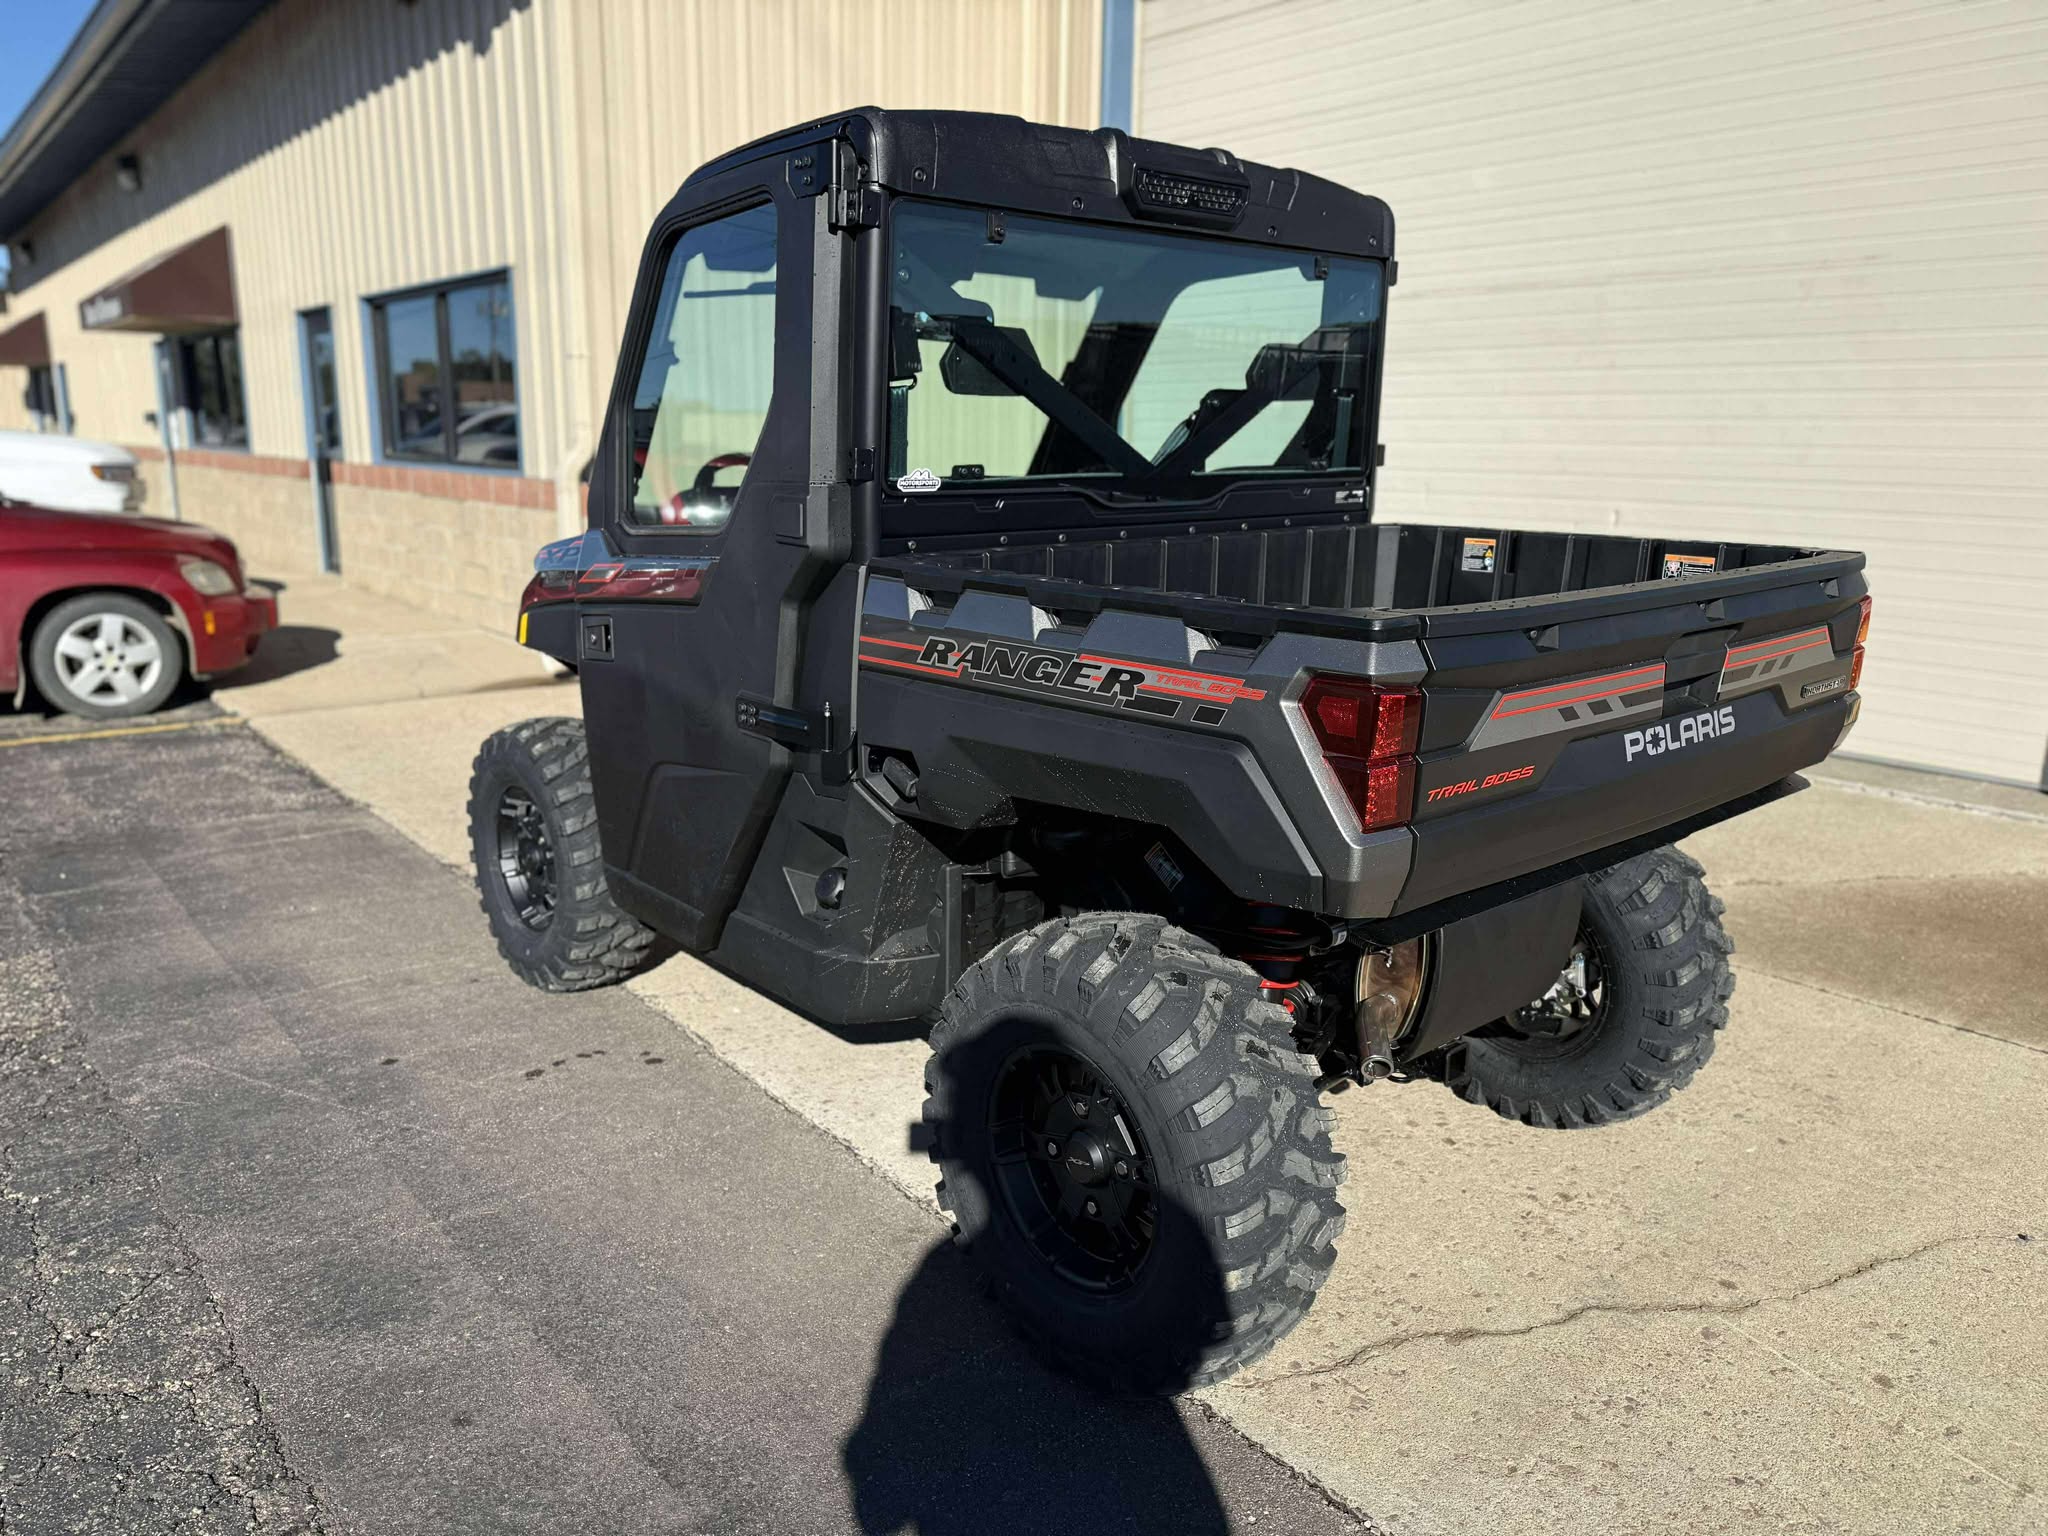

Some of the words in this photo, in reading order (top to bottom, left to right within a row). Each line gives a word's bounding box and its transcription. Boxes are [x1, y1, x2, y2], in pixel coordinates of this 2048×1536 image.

[917, 636, 1146, 700] RANGER
[1156, 674, 1205, 690] TRAIL
[1207, 683, 1267, 701] BOSS
[1623, 706, 1736, 762] POLARIS
[1427, 779, 1479, 803] TRAIL
[1481, 765, 1536, 789] BOSS
